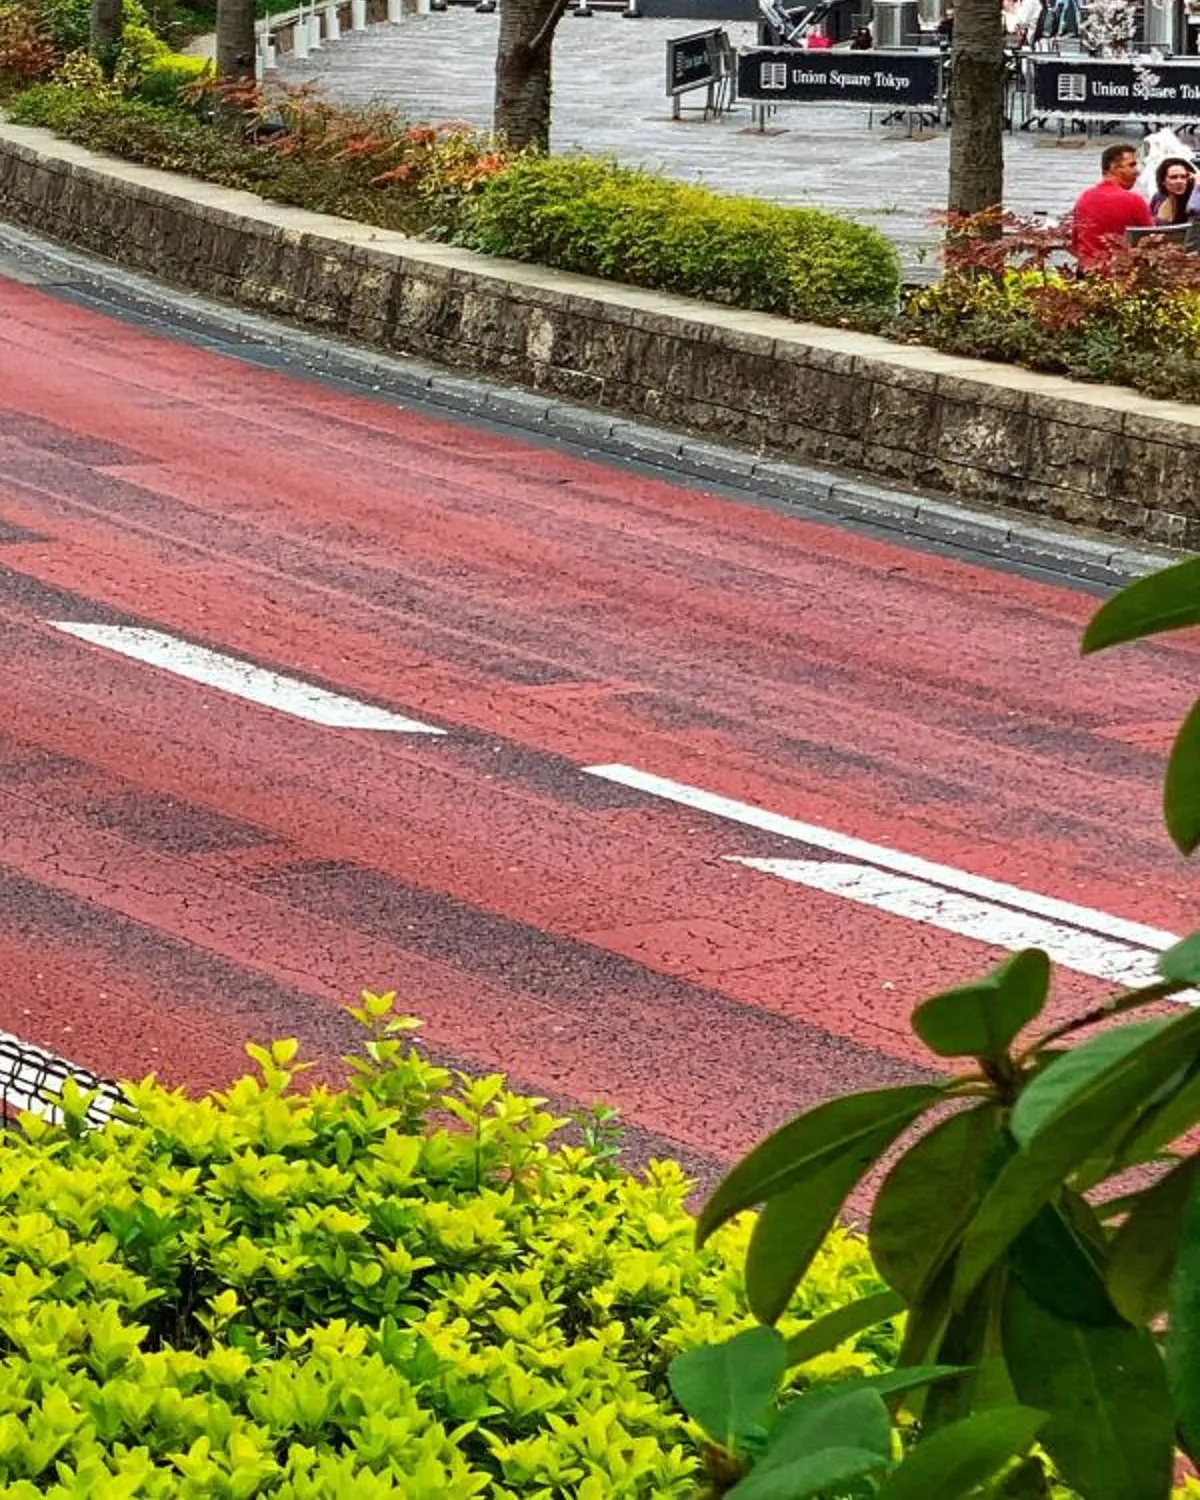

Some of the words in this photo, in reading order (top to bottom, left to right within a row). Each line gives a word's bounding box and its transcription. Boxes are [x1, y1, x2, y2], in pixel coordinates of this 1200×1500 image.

[792, 69, 827, 85] Union
[829, 70, 871, 88] Square
[874, 73, 910, 90] Tokyo
[1092, 81, 1129, 97] Union
